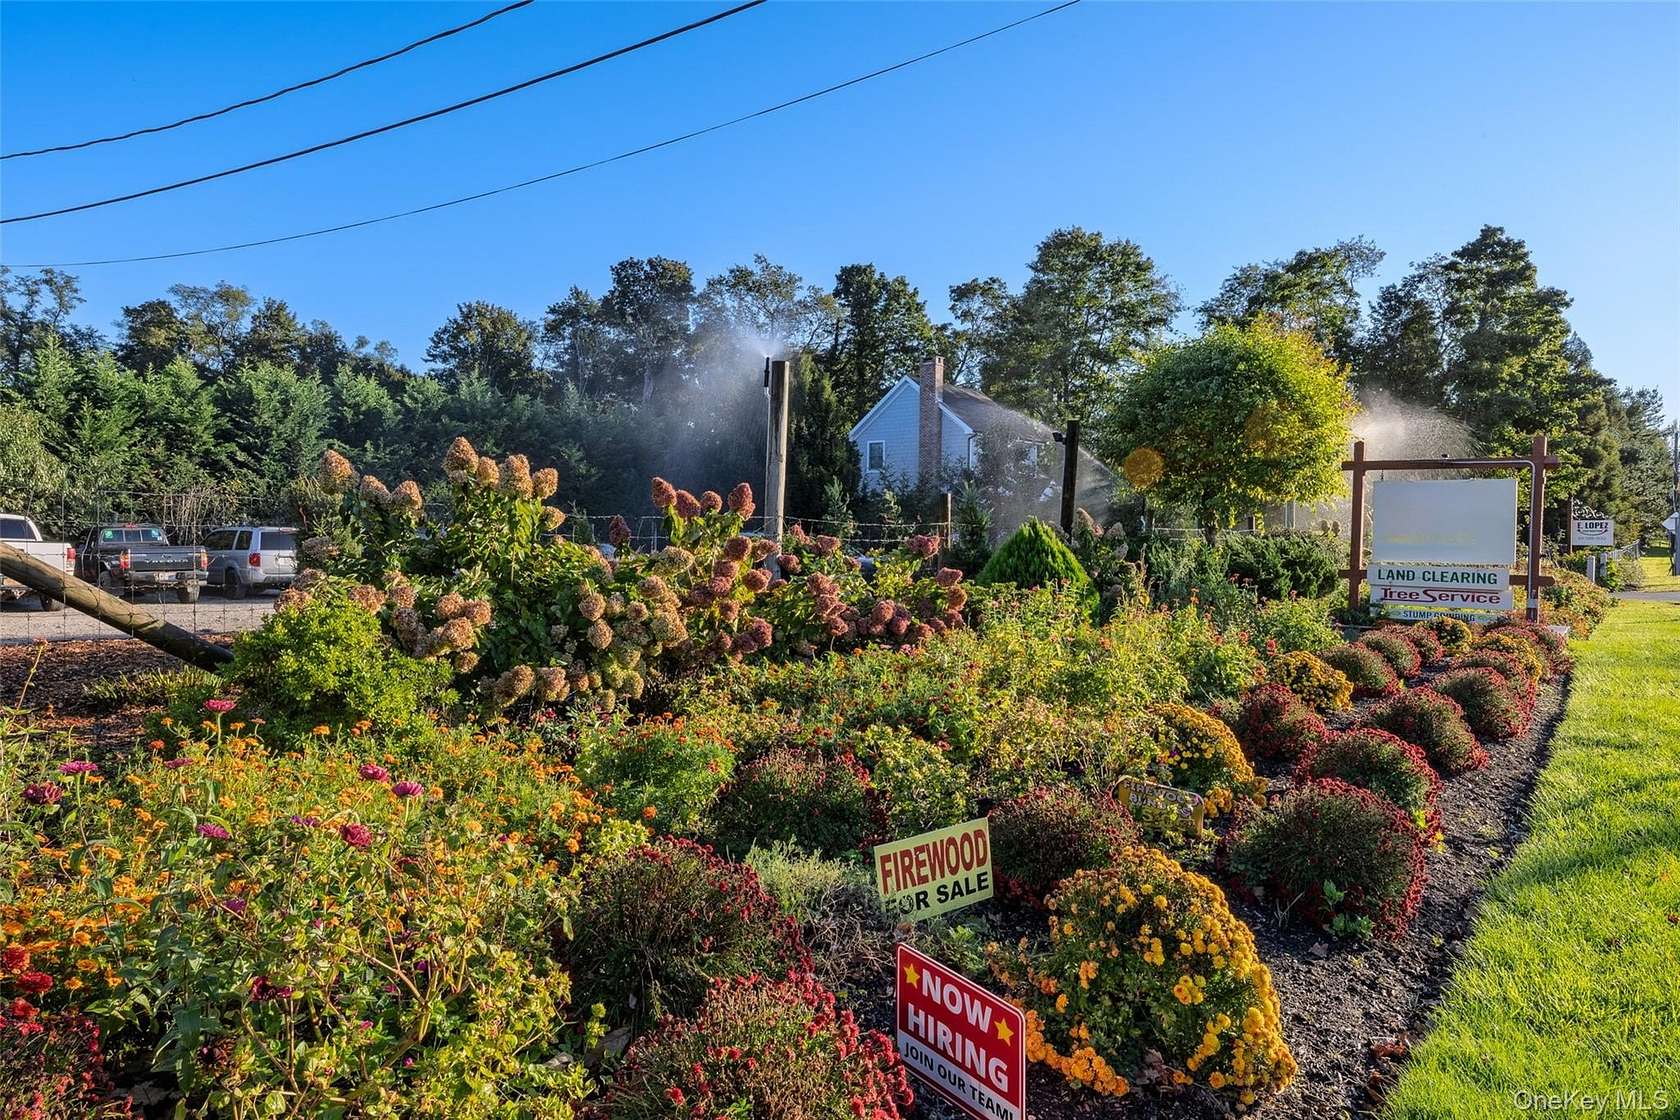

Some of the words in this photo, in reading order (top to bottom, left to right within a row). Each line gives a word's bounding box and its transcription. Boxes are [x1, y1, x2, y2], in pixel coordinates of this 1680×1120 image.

[1585, 521, 1609, 530] LOPEZ
[1377, 569, 1416, 581] LAND
[1422, 570, 1498, 585] CLEARING
[1380, 587, 1420, 600] Tree
[1422, 588, 1500, 604] Service
[1403, 610, 1432, 619] STUMP
[880, 828, 988, 896] FIREWOOD
[885, 890, 931, 915] FOR
[936, 871, 990, 904] SALE
[922, 967, 993, 1033] NOW
[904, 1042, 934, 1072] JOIN
[937, 1064, 967, 1095] OUR
[907, 1002, 1009, 1093] HIRING
